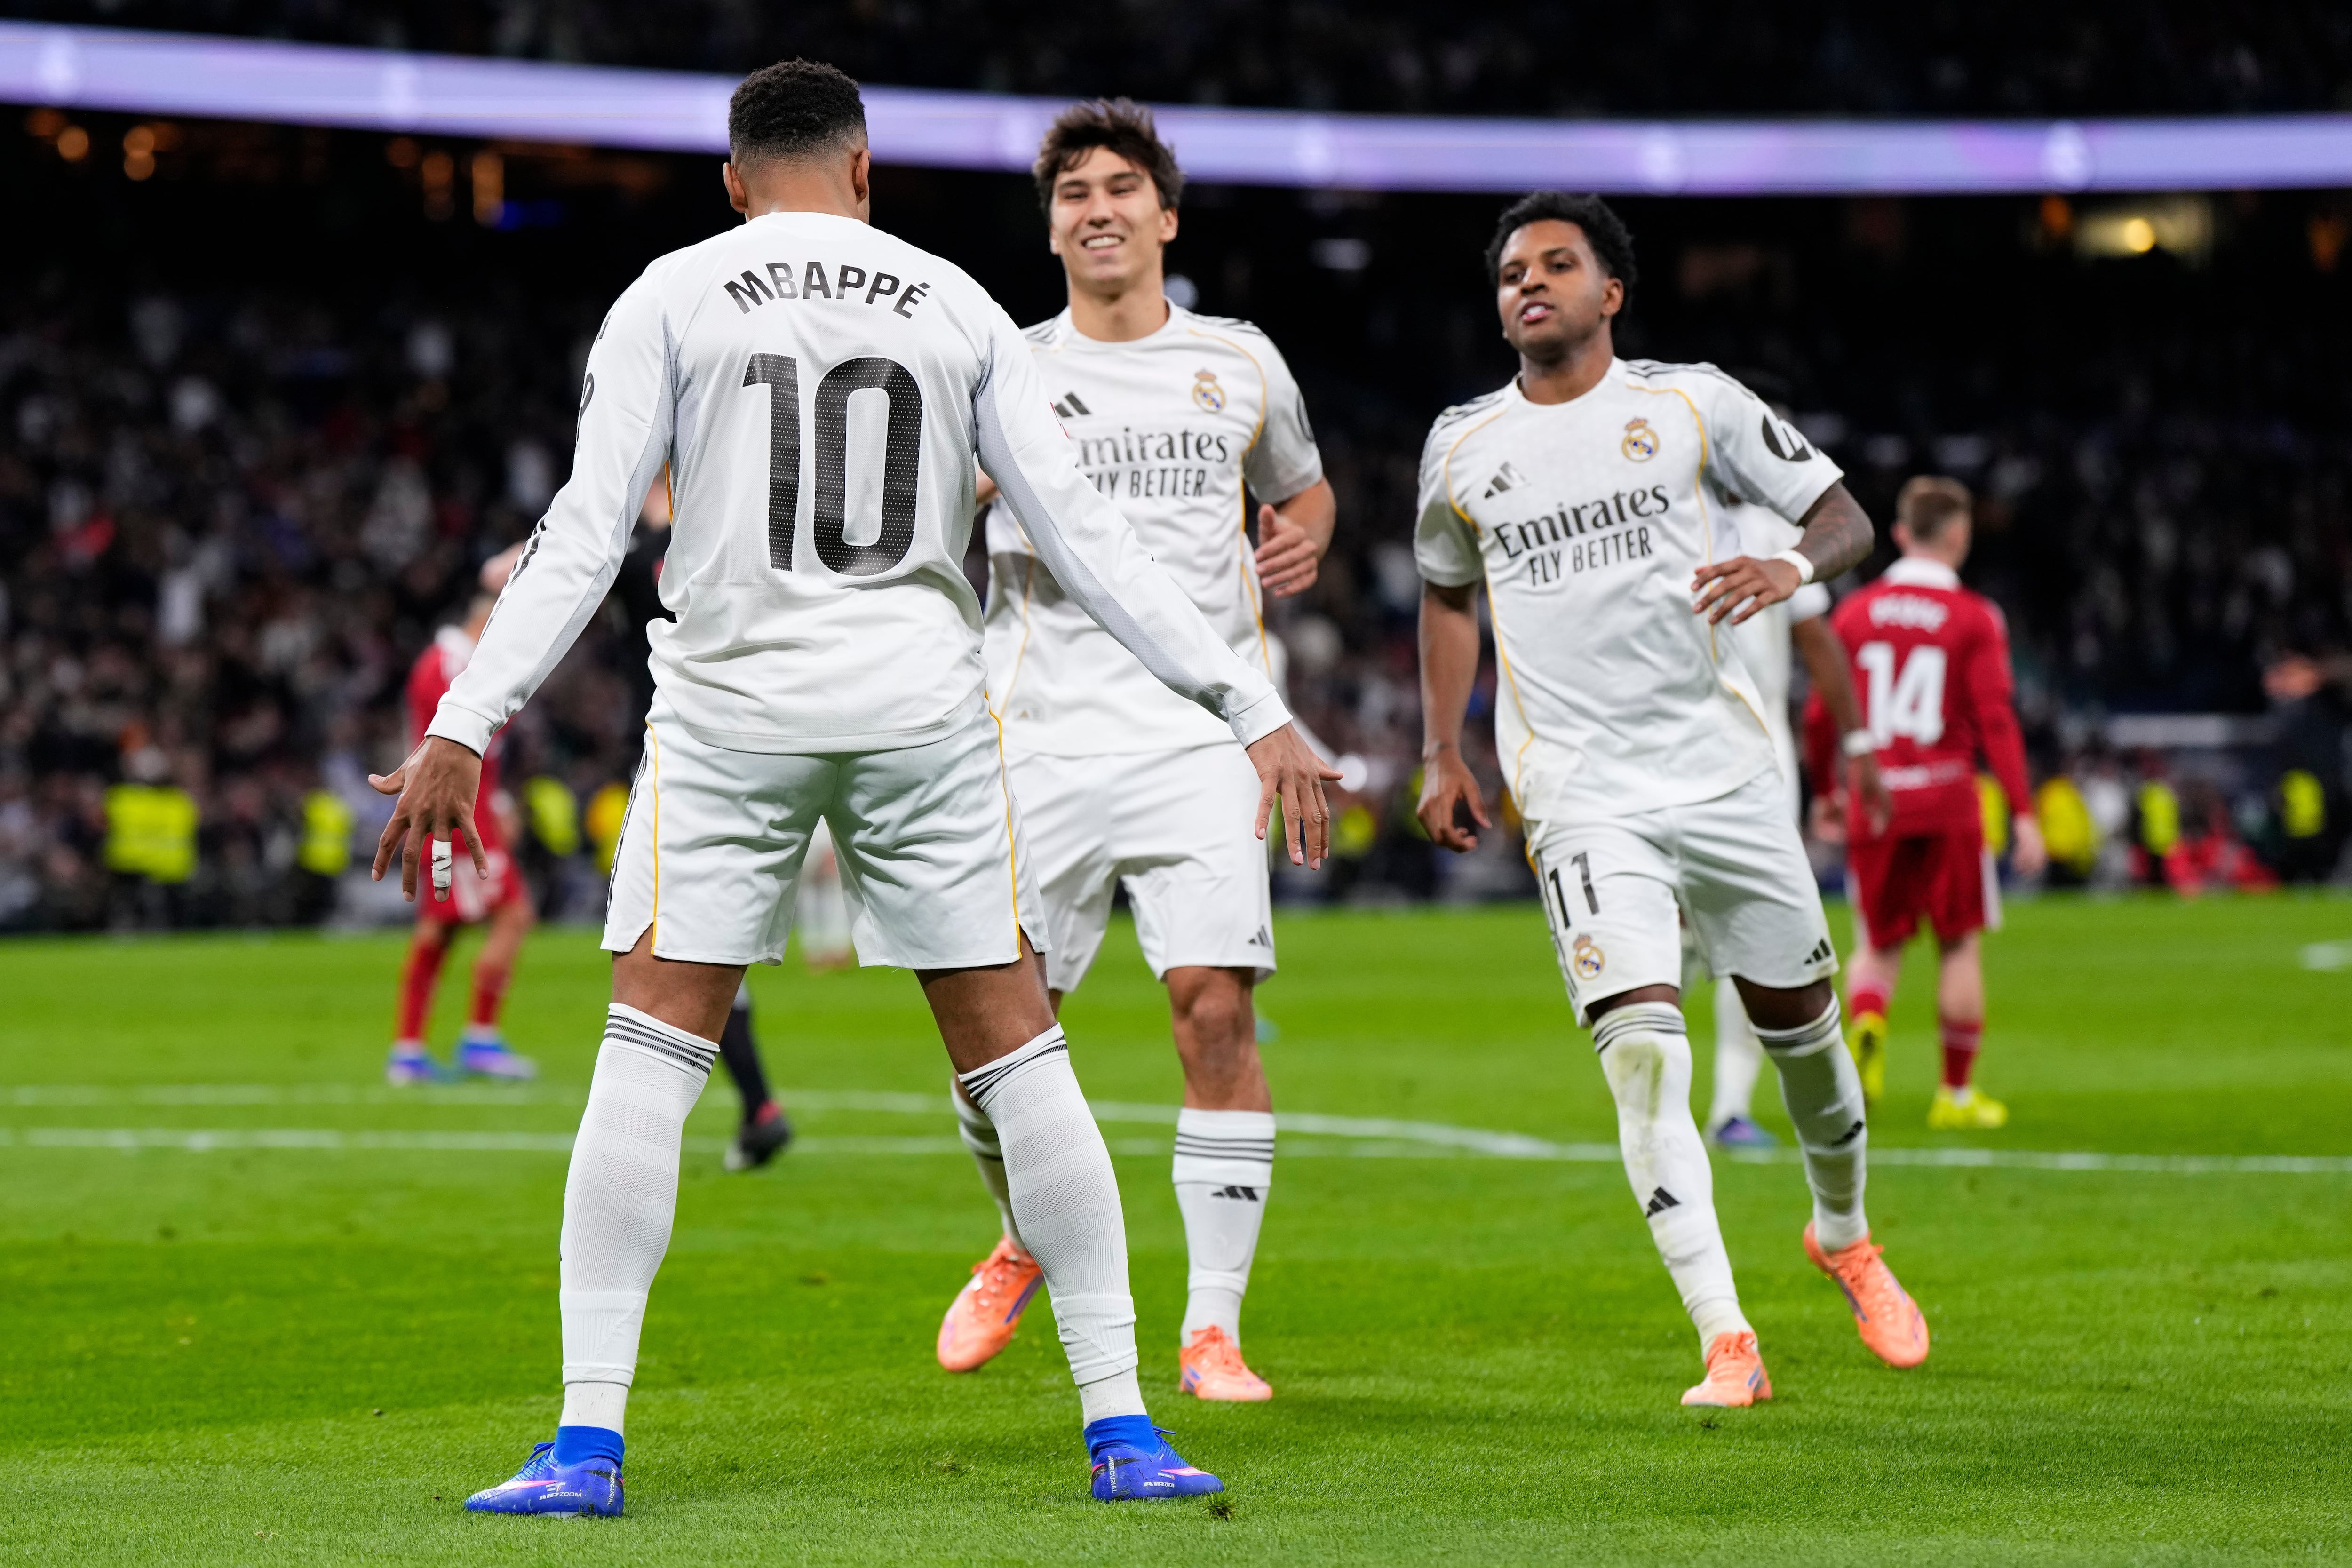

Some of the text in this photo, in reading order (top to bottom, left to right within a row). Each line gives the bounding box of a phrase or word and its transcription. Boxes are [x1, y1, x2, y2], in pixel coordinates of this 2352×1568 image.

[724, 261, 932, 319] MBAPPÉ
[742, 353, 922, 576] 10
[1073, 426, 1228, 467] mirates
[1129, 468, 1206, 498] BETTER
[1493, 484, 1669, 559] Emirates
[1529, 526, 1653, 587] FLY BETTER
[1856, 640, 1947, 748] 14
[1549, 852, 1600, 930] 11
[607, 1468, 617, 1506] MERCURIAL
[1107, 1455, 1118, 1494] MERCURIAL
